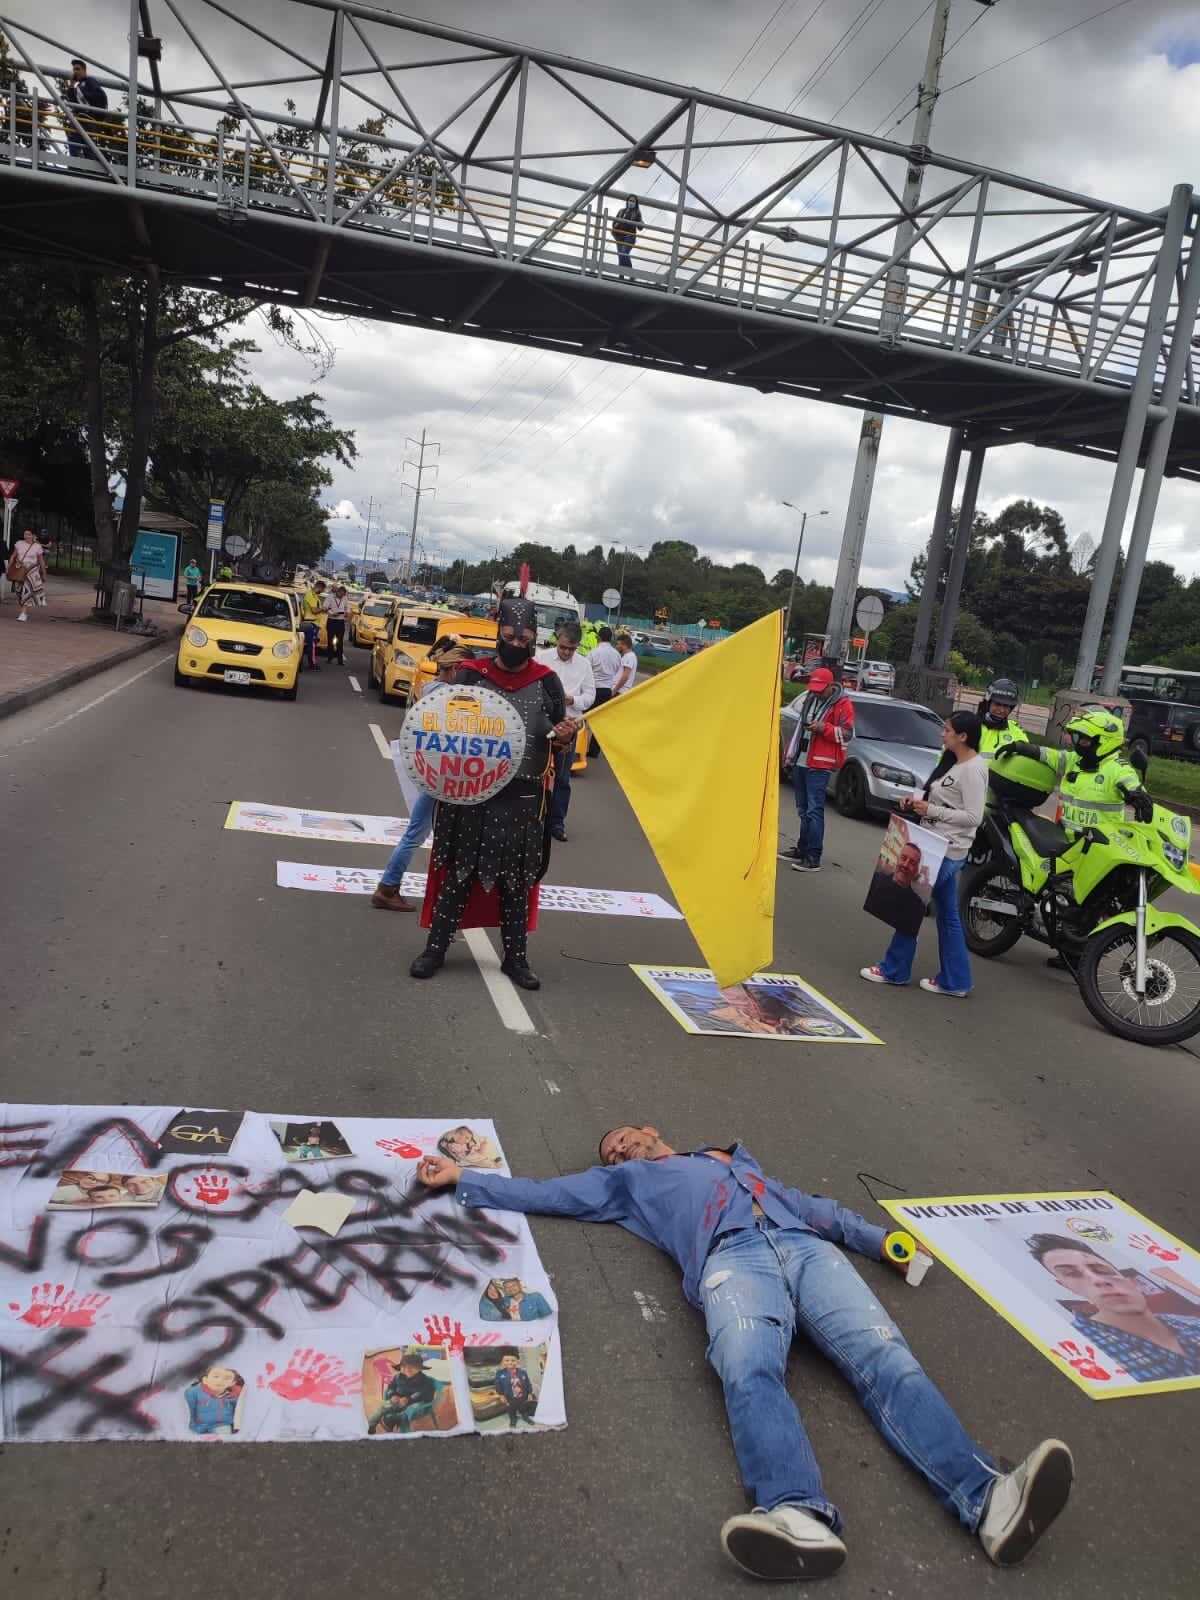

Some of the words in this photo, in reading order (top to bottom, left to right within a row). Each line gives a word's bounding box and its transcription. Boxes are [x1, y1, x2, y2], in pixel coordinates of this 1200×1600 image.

[423, 712, 441, 731] EL
[412, 730, 512, 759] TAXISTA
[414, 751, 438, 790] SE
[443, 759, 509, 798] RINDE
[440, 755, 485, 778] NO
[648, 970, 800, 987] DESAPCIDO
[901, 1203, 999, 1218] VICTIMA
[1000, 1201, 1038, 1214] DE
[1036, 1198, 1113, 1212] HURTO
